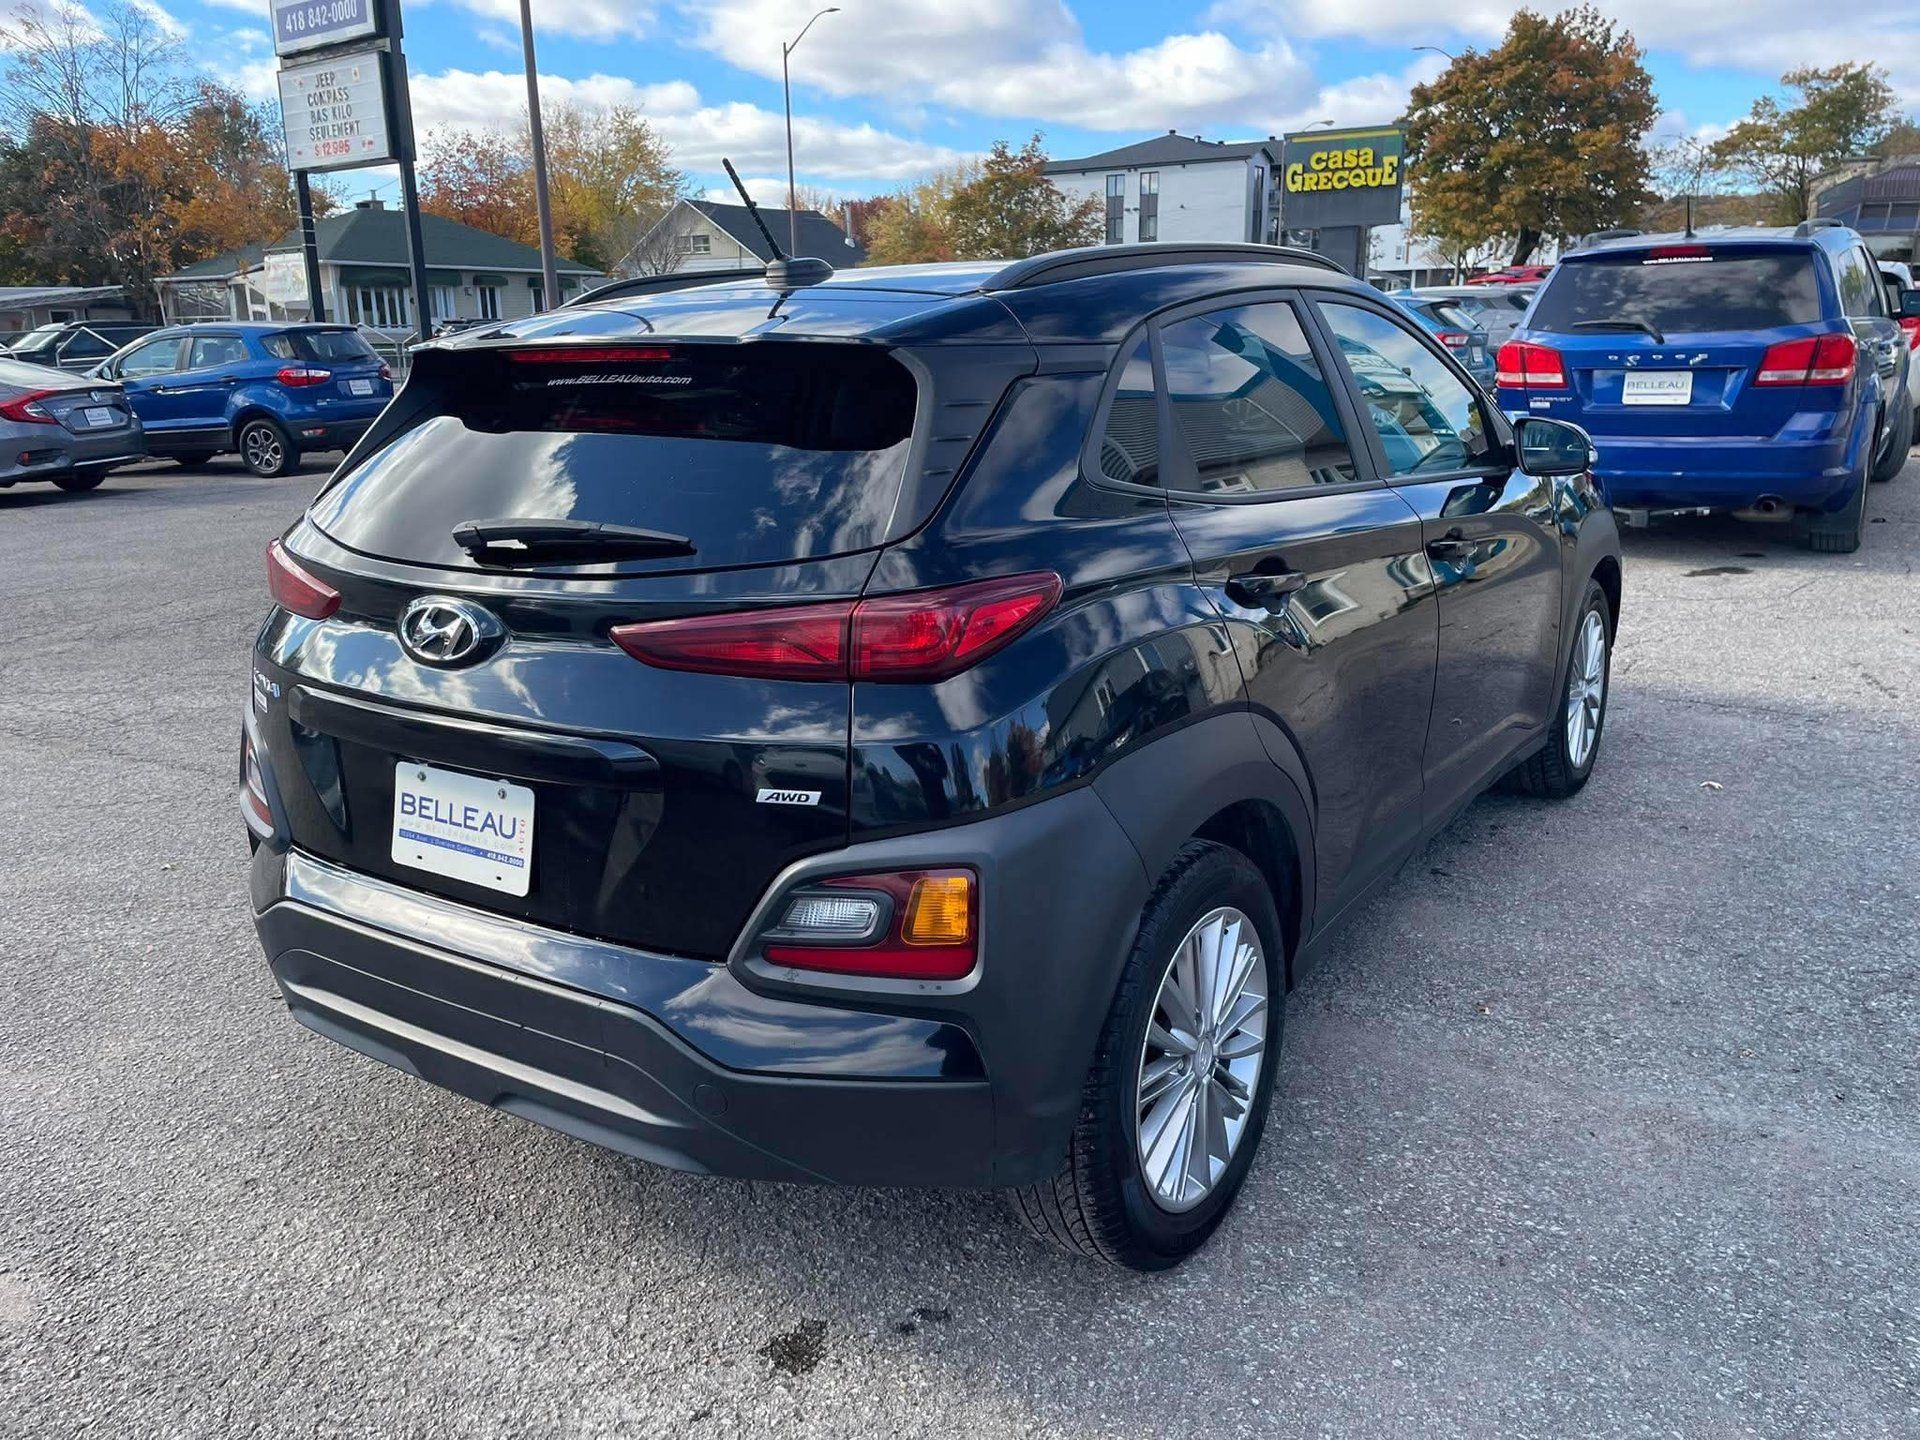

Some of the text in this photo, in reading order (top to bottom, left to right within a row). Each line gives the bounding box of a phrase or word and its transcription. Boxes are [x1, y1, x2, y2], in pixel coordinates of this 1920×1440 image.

[286, 0, 358, 32] 418 842-0000
[315, 70, 336, 88] JEEP
[307, 87, 350, 107] COMPASS
[310, 104, 353, 124] BAS KILO
[309, 120, 361, 141] SEULEMENT
[1286, 155, 1399, 192] GRECQUE
[1627, 380, 1685, 390] BELLEAU
[765, 792, 810, 803] AWD
[401, 792, 517, 839] BELLEAU
[518, 819, 527, 853] AUTO
